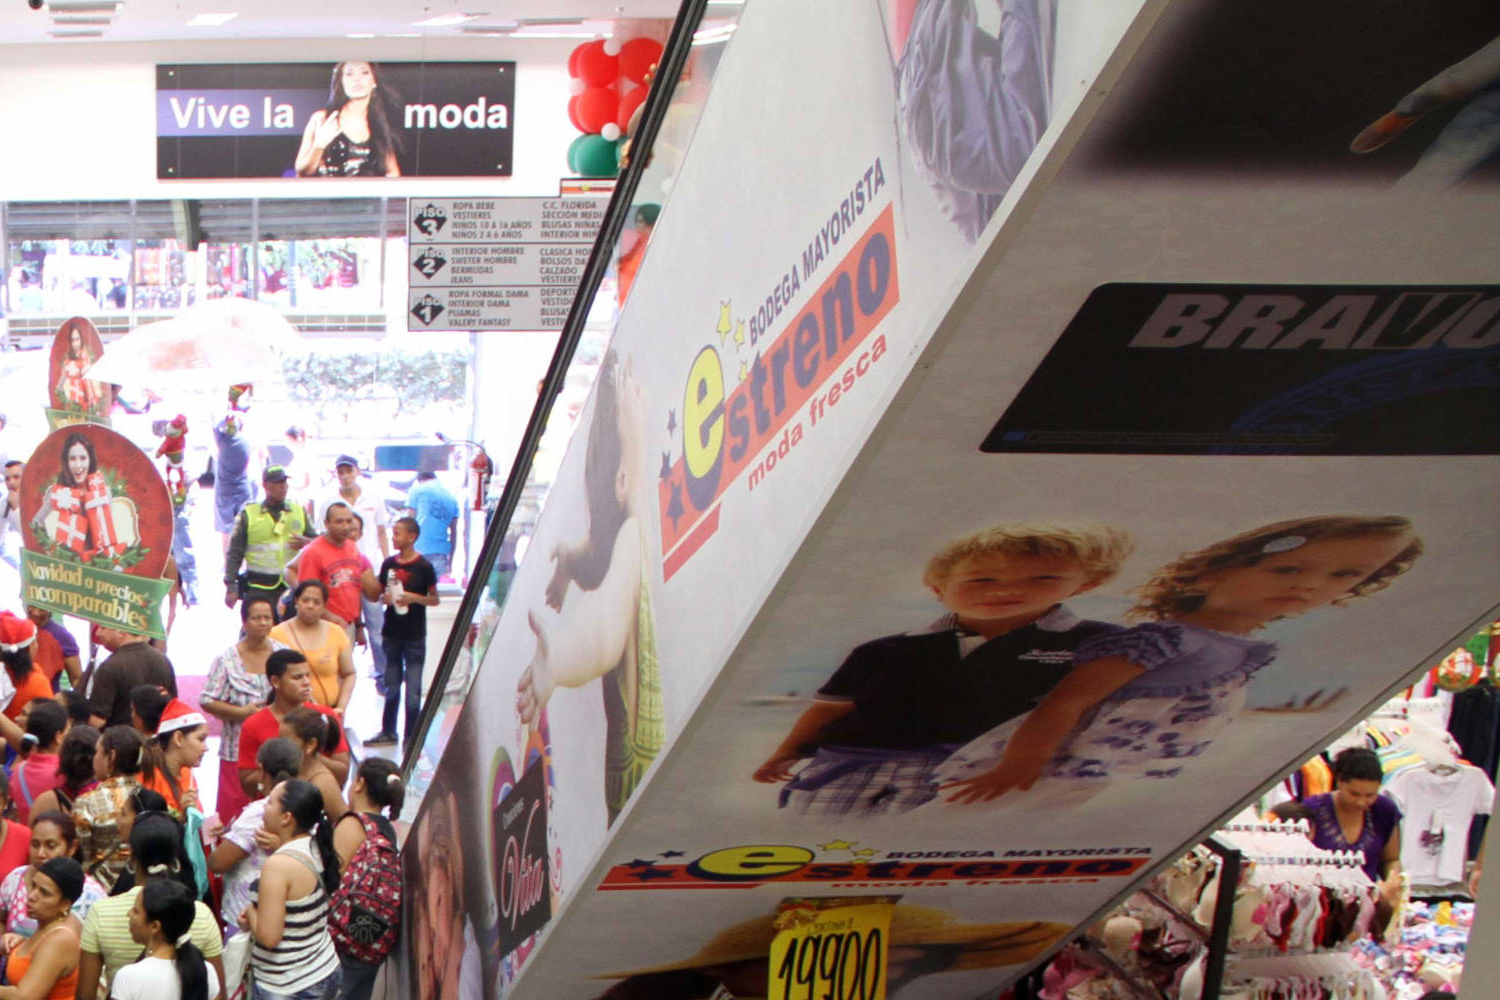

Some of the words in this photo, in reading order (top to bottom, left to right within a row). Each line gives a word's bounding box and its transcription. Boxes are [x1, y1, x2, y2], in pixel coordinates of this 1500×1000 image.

[169, 97, 250, 129] Vive
[263, 97, 295, 129] la
[404, 97, 508, 129] moda
[452, 202, 474, 210] ROPA
[476, 202, 495, 210] BEBE
[561, 201, 597, 210] FLORIDA
[414, 206, 446, 218] PISO
[453, 211, 492, 219] VESTIERES
[580, 211, 603, 219] MEDI
[541, 220, 572, 229] BLUSAS
[540, 230, 579, 239] INTERIOR
[451, 247, 489, 255] INTERIOR
[490, 247, 524, 255] HOMBRE
[749, 265, 801, 342] BODEGA
[802, 157, 885, 276] MAYORISTA
[422, 258, 436, 273] 2
[483, 257, 517, 265] HOMBRE
[540, 257, 572, 265] BOLSOS
[451, 266, 494, 275] BERMUDAS
[539, 266, 578, 275] CALZADO
[450, 276, 474, 284] JEANS
[448, 290, 470, 298] ROPA
[472, 290, 504, 298] FORMAL
[506, 290, 529, 298] DAMA
[448, 300, 485, 308] INTERIOR
[487, 300, 510, 308] DAMA
[420, 306, 433, 322] 1
[683, 231, 891, 503] estreno
[748, 422, 803, 491] moda
[809, 334, 887, 426] fresca
[26, 559, 83, 586] Navidad
[84, 578, 93, 589] a
[96, 580, 145, 607] precios
[886, 849, 994, 860] BODEGA
[1004, 846, 1153, 858] MAYORISTA
[690, 844, 1133, 881] estreno
